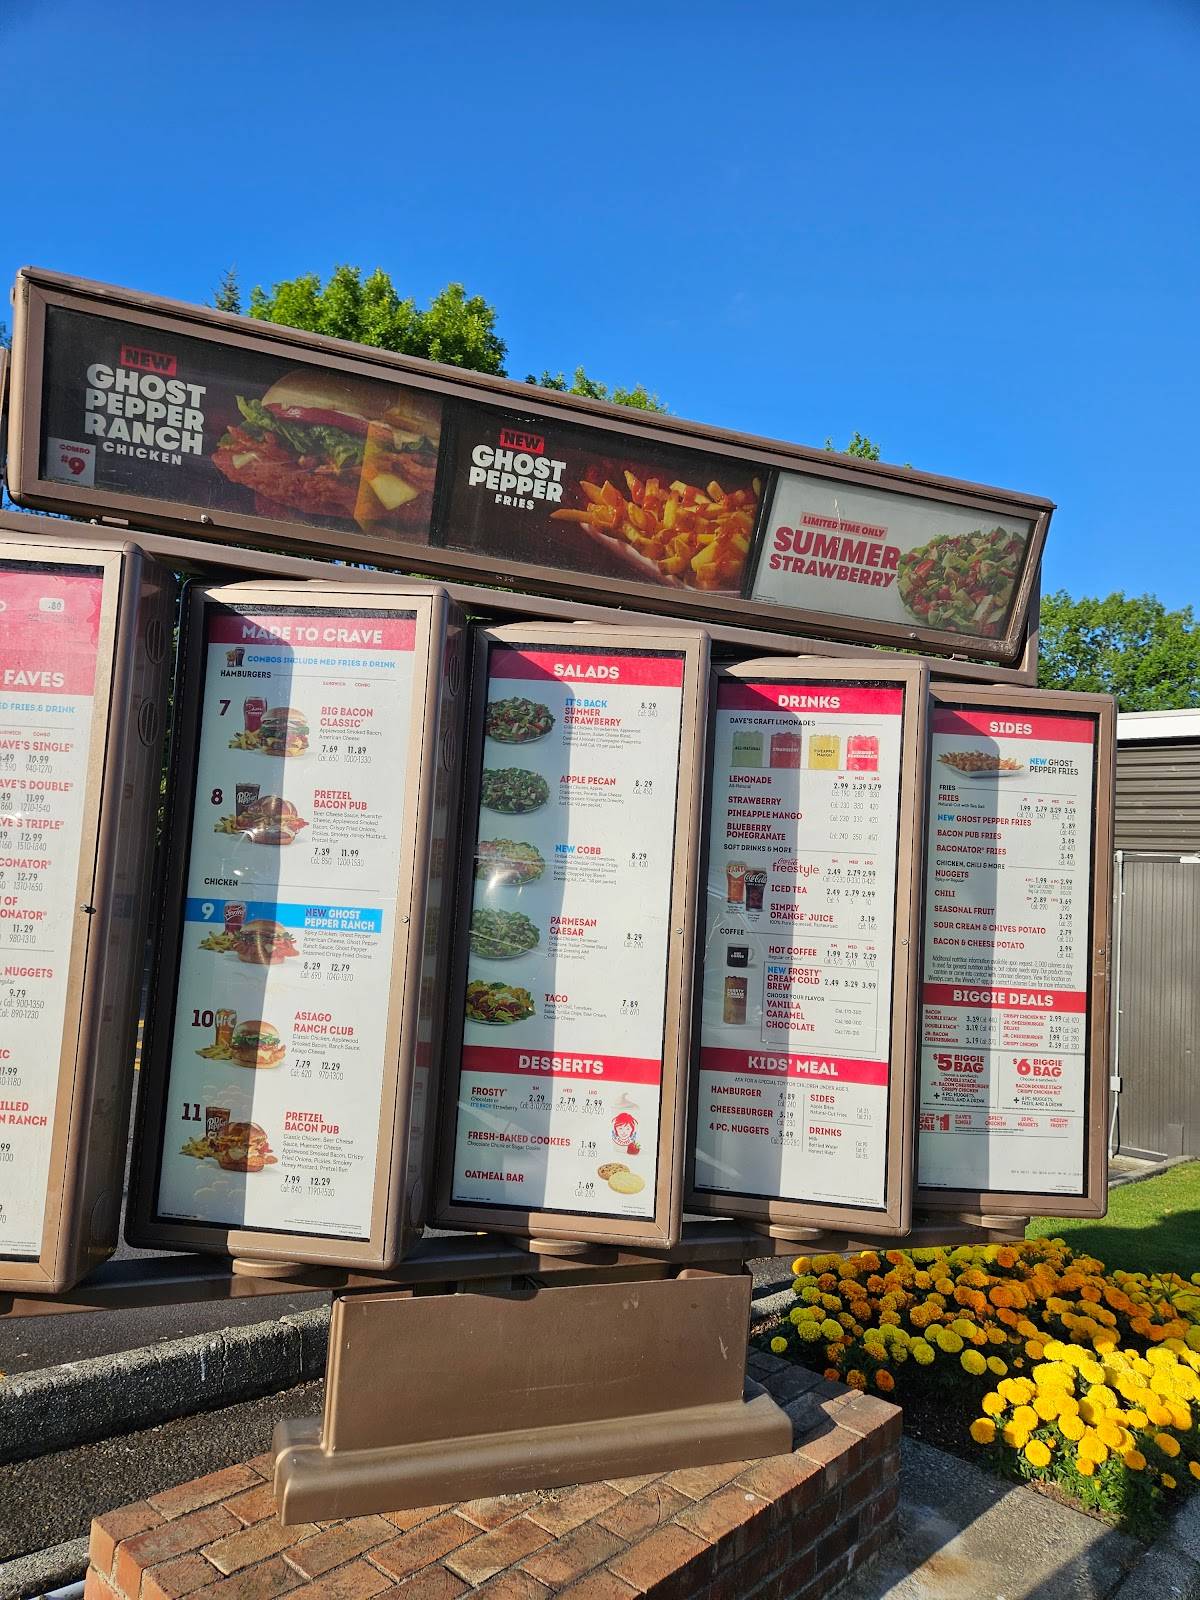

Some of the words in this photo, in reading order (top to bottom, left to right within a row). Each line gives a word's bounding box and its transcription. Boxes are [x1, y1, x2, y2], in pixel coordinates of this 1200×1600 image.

[124, 348, 173, 372] NEW
[86, 363, 207, 407] GHOST
[86, 388, 205, 432] PEPPER
[84, 412, 203, 456] RANCH
[504, 431, 542, 450] NEW
[59, 443, 91, 455] COMBO
[102, 442, 182, 465] CHICKEN
[470, 445, 567, 483] GHOST
[468, 465, 563, 503] PEPPER
[494, 493, 534, 510] FRIES
[802, 514, 838, 530] LIMITED
[840, 520, 860, 534] TIME
[862, 524, 885, 538] ONLY
[773, 526, 901, 570] SUMMER
[768, 554, 896, 589] STRAWBERRY
[242, 625, 291, 641] MADE
[296, 628, 319, 640] TO
[323, 628, 383, 644] CRAVE
[284, 657, 317, 665] INCLUDE
[320, 658, 336, 666] MED
[338, 659, 360, 667] FRIES
[221, 670, 271, 678] HAMBURGERS
[554, 664, 620, 679] SALADS
[4, 669, 64, 687] FAVES
[11, 703, 35, 711] FRIES
[584, 699, 607, 708] BACK
[778, 695, 840, 708] DRINKS
[219, 700, 230, 715] 7
[321, 706, 338, 715] BIG
[341, 707, 373, 717] BACON
[565, 708, 600, 716] SUMMER
[564, 716, 621, 726] STRAWBERRY
[990, 722, 1032, 735] SIDES
[28, 755, 49, 763] 10.99
[1030, 766, 1056, 774] PEPPER
[560, 776, 586, 784] APPLE
[588, 777, 616, 785] PECAN
[729, 775, 772, 784] LEMONADE
[26, 794, 44, 803] 11.99
[211, 788, 223, 805] 8
[315, 790, 352, 799] PRETZEL
[314, 800, 346, 809] BACON
[349, 801, 368, 810] PUB
[728, 796, 781, 806] STRAWBERRY
[728, 810, 770, 818] PINEAPPLE
[773, 812, 802, 820] MANGO
[983, 817, 1009, 825] PEPPER
[727, 823, 771, 831] BLUEBERRY
[21, 833, 42, 841] 12.99
[727, 831, 786, 840] POMEGRANATE
[314, 848, 330, 856] 7.39
[341, 849, 358, 857] 11.99
[556, 844, 575, 853] NEW
[577, 846, 601, 855] COBB
[986, 847, 1006, 855] FRIES
[772, 863, 820, 877] freestyle
[936, 870, 969, 878] NUGGETS
[18, 872, 38, 881] 12.79
[205, 878, 238, 886] CHICKEN
[5, 897, 18, 905] OF
[202, 903, 214, 919] 9
[306, 908, 327, 917] NEW
[329, 910, 360, 919] GHOST
[934, 905, 972, 914] SEASONAL
[551, 917, 597, 926] PARMESAN
[809, 914, 833, 922] JUICE
[13, 924, 33, 932] 11.29
[305, 918, 339, 928] PEPPER
[342, 920, 374, 930] RANCH
[934, 921, 953, 929] SOUR
[955, 922, 981, 930] CREAM
[989, 925, 1017, 933] CHIVES
[1018, 926, 1046, 934] POTATO
[550, 927, 584, 936] CAESAR
[933, 938, 960, 946] BACON
[968, 940, 995, 948] CHEESE
[997, 941, 1024, 949] POTATO
[769, 946, 785, 954] HOT
[787, 947, 817, 956] COFFEE
[5, 967, 53, 978] NUGGETS
[304, 962, 321, 970] 8.29
[331, 964, 350, 972] 12.79
[10, 989, 26, 997] 9.79
[545, 994, 568, 1002] TACO
[953, 990, 1005, 1004] BIGGIE
[1010, 993, 1054, 1006] DEALS
[767, 1000, 800, 1009] VANILLA
[192, 1010, 214, 1027] 10
[295, 1012, 332, 1022] ASIAGO
[767, 1011, 804, 1020] CARAMEL
[294, 1024, 327, 1034] RANCH
[330, 1026, 354, 1035] CLUB
[766, 1021, 815, 1031] CHOCOLATE
[295, 1060, 310, 1068] 7.79
[322, 1062, 340, 1071] 12.29
[519, 1056, 604, 1074] DESSERTS
[749, 1056, 792, 1070] KIDS'
[797, 1060, 838, 1076] MEAL
[933, 1054, 952, 1072] $5
[954, 1061, 984, 1073] BAG
[1013, 1059, 1030, 1075] $6
[1034, 1066, 1061, 1077] BAG
[711, 1086, 761, 1097] HAMBURGER
[810, 1095, 835, 1103] SIDES
[182, 1103, 201, 1121] 11
[710, 1105, 773, 1117] CHEESEBURGER
[9, 1116, 47, 1126] RANCH
[286, 1112, 324, 1123] PRETZEL
[285, 1122, 318, 1133] BACON
[321, 1123, 340, 1134] PUB
[732, 1125, 769, 1135] NUGGETS
[809, 1127, 841, 1136] DRINKS
[468, 1131, 528, 1143] FRESH-BAKED
[531, 1137, 570, 1146] COOKIES
[285, 1175, 300, 1184] 7.99
[310, 1177, 331, 1186] 12.29
[465, 1170, 504, 1180] OATMEAL
[507, 1173, 524, 1182] BAR
